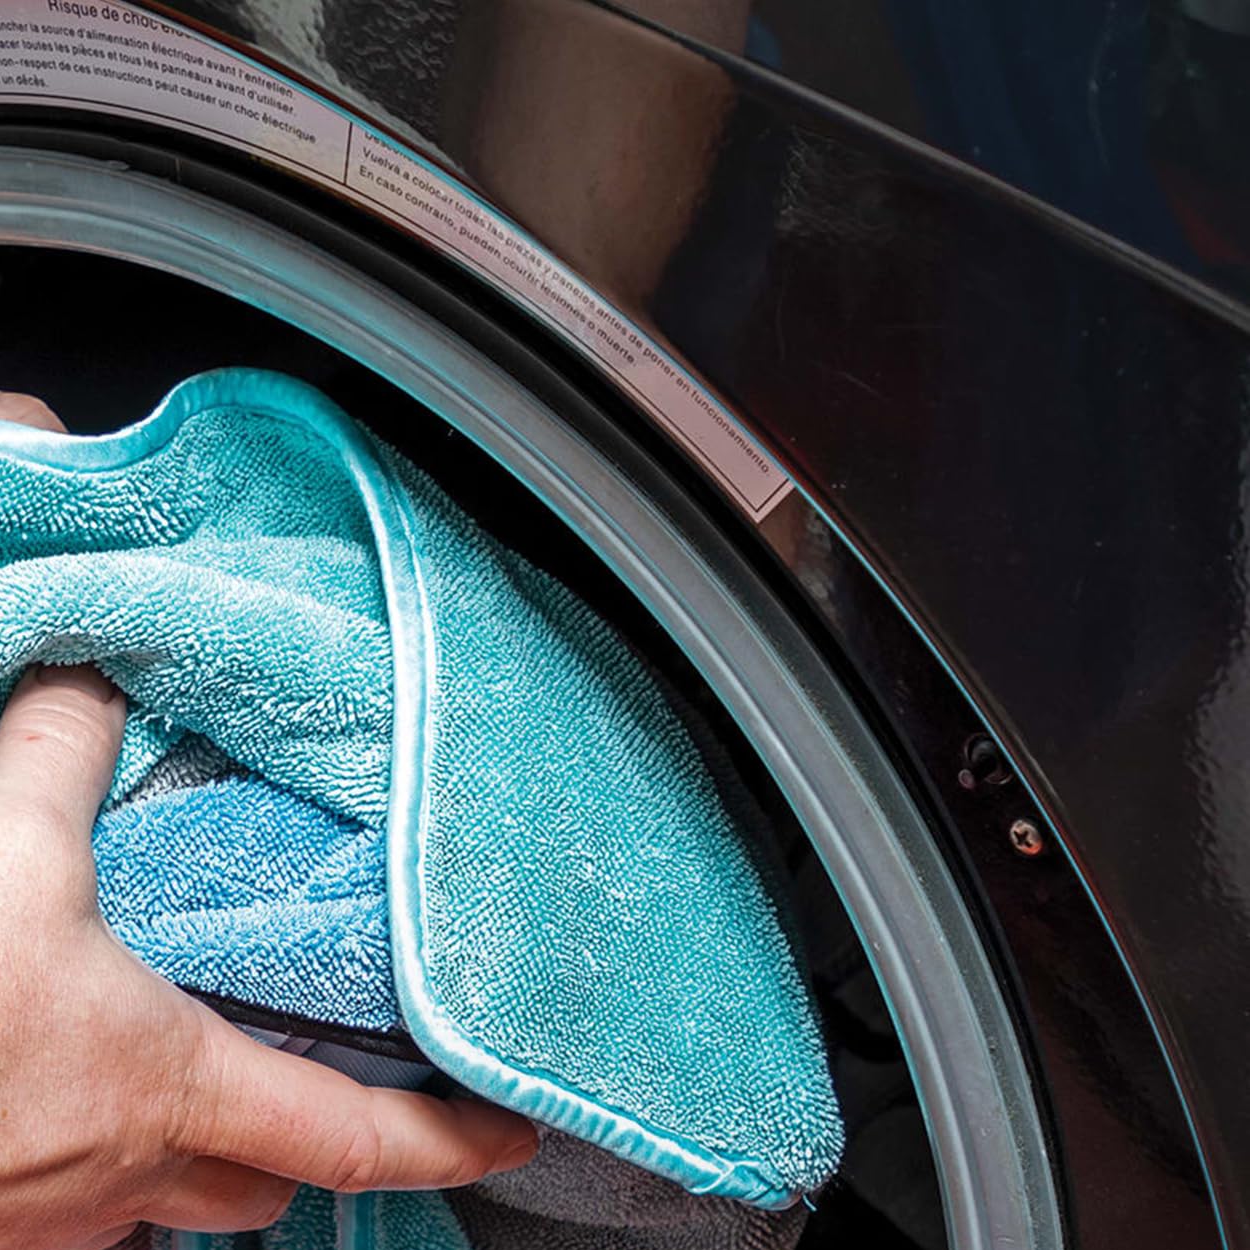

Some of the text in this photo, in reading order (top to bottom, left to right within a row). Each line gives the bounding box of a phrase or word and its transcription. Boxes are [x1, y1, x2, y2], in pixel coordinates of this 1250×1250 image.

[47, 0, 97, 18] Risque
[101, 5, 119, 22] de
[359, 164, 375, 181] En
[375, 175, 403, 197] caso
[458, 225, 502, 258] pueden
[502, 255, 540, 285] ocurrir
[540, 282, 587, 322] lesiones
[587, 320, 596, 331] o
